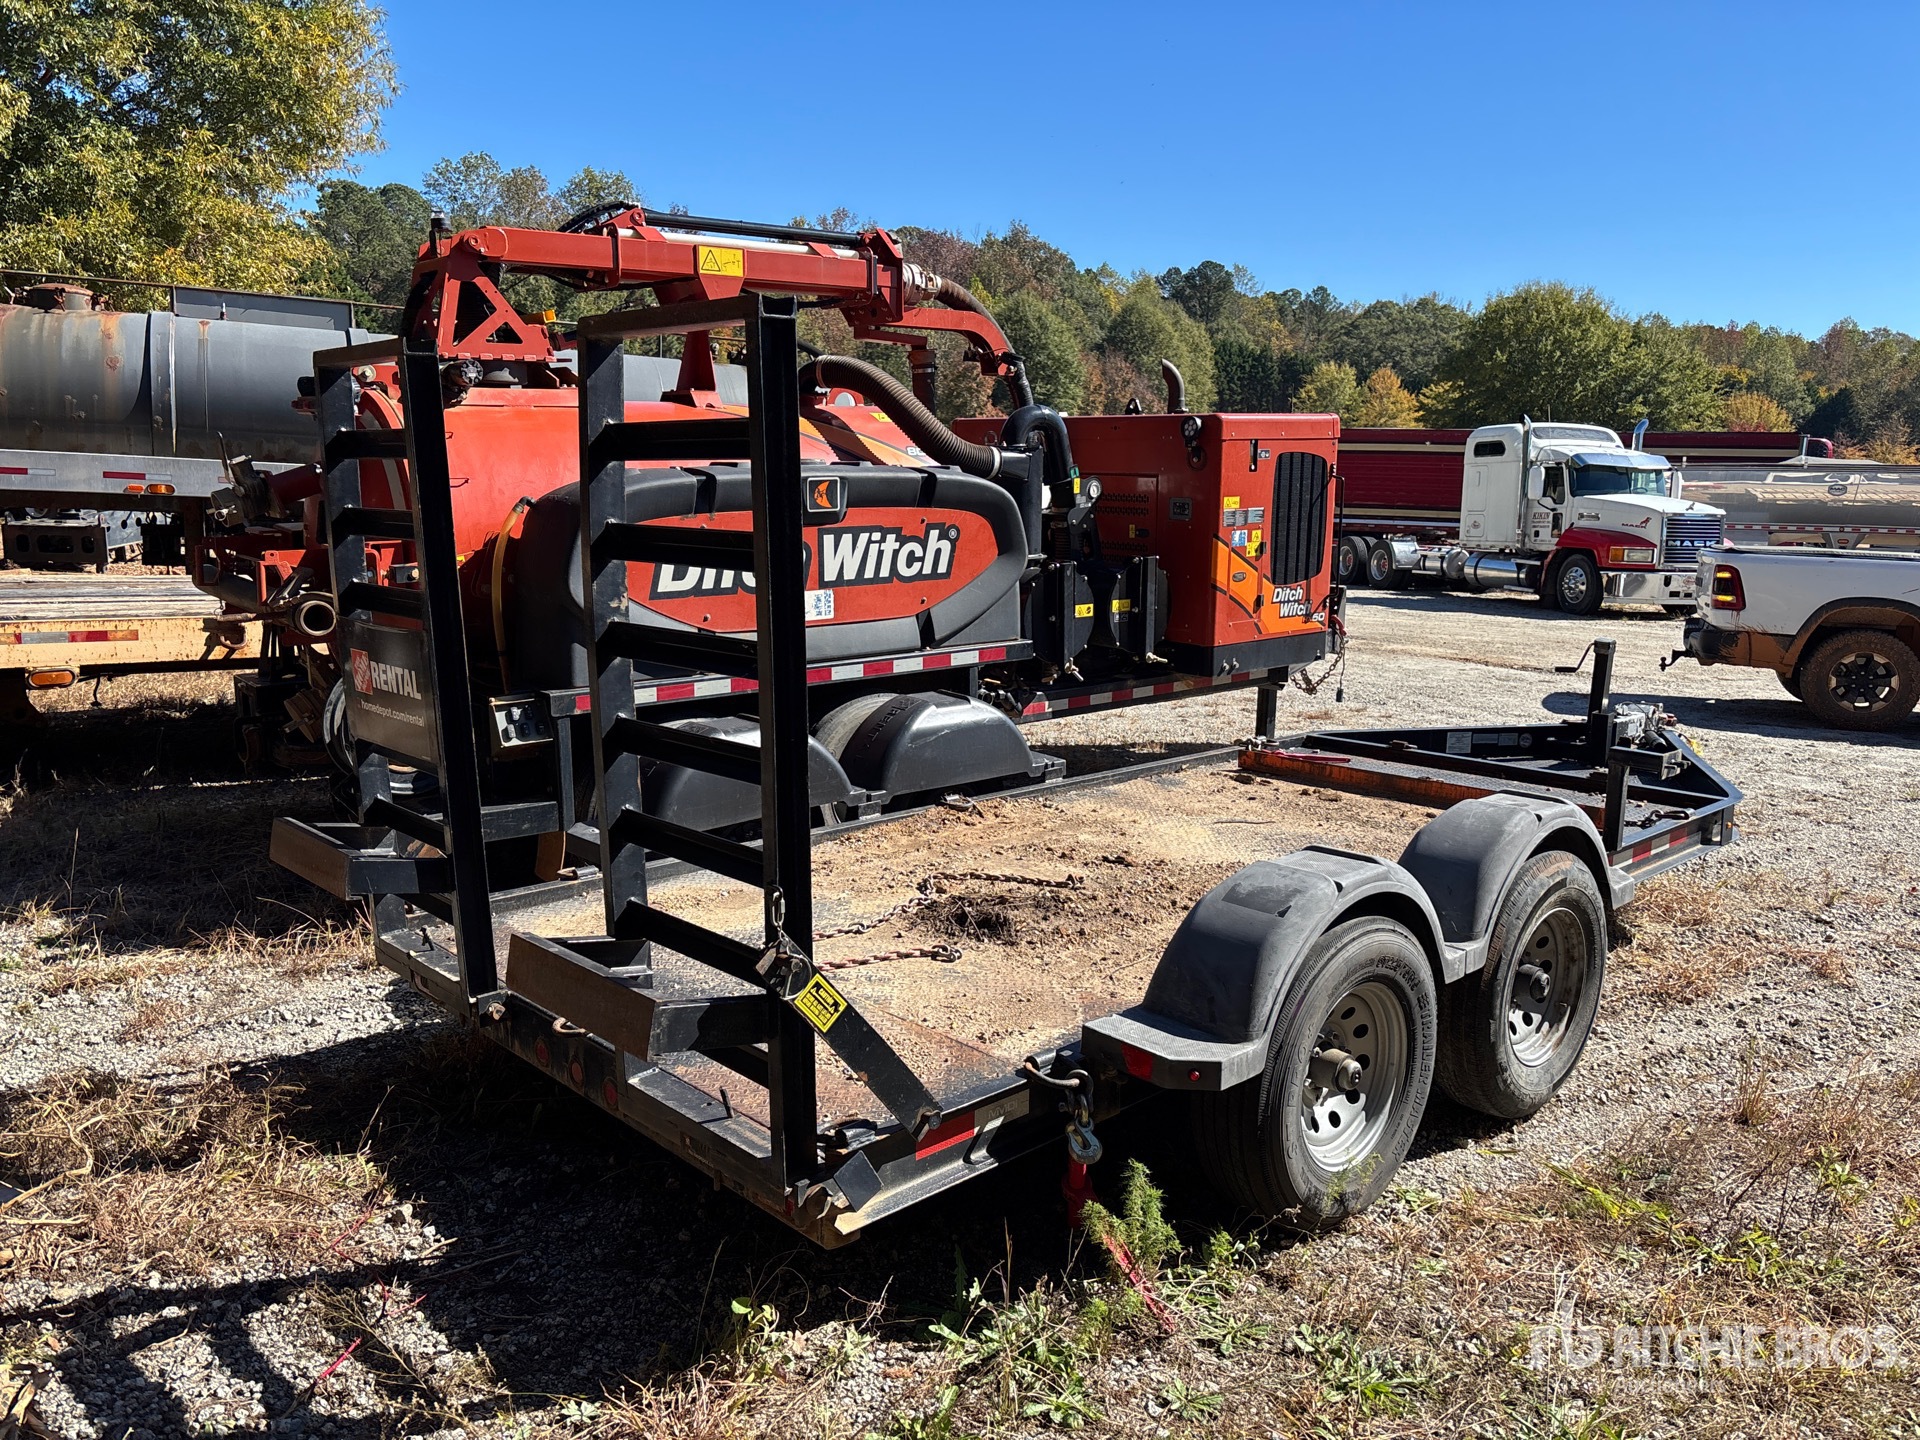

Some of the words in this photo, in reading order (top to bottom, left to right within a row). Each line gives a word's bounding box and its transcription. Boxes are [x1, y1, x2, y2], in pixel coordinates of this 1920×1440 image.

[1272, 586, 1304, 603] Ditch
[1280, 600, 1311, 618] Witch
[370, 660, 422, 701] RENTAL
[360, 698, 425, 727] homedepot.com/rental
[1418, 1012, 1435, 1086] TRAILER
[1392, 1089, 1427, 1163] MASTER
